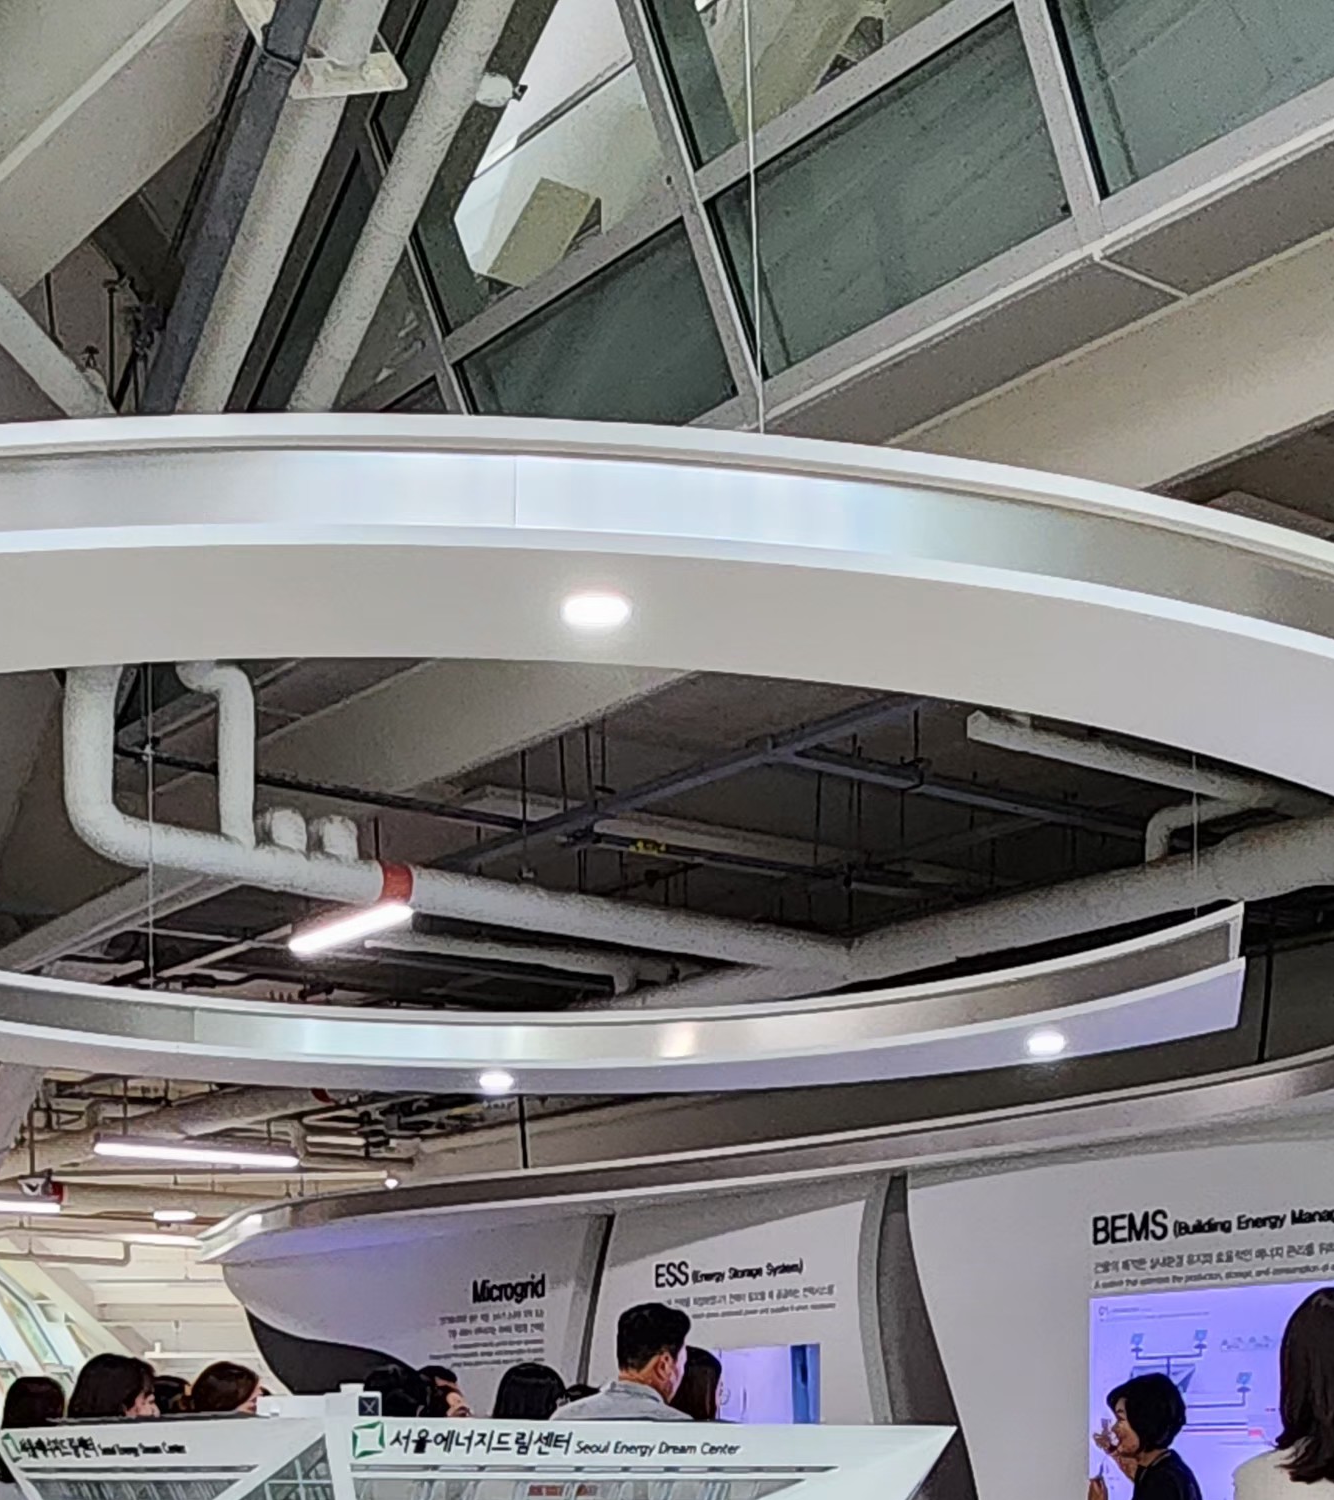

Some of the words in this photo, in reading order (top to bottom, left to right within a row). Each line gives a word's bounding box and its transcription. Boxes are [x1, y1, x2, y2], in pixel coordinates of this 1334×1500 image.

[1092, 1208, 1168, 1245] BEMS
[1173, 1217, 1232, 1239] (Building
[1236, 1213, 1287, 1231] Energy
[472, 1273, 546, 1304] Microgrid
[655, 1260, 689, 1288] ESS
[389, 1428, 573, 1457] 서울에너지드림센터
[575, 1440, 611, 1454] Seoul
[614, 1441, 656, 1457] Energy
[658, 1441, 697, 1455] Dream
[701, 1442, 741, 1455] Center
